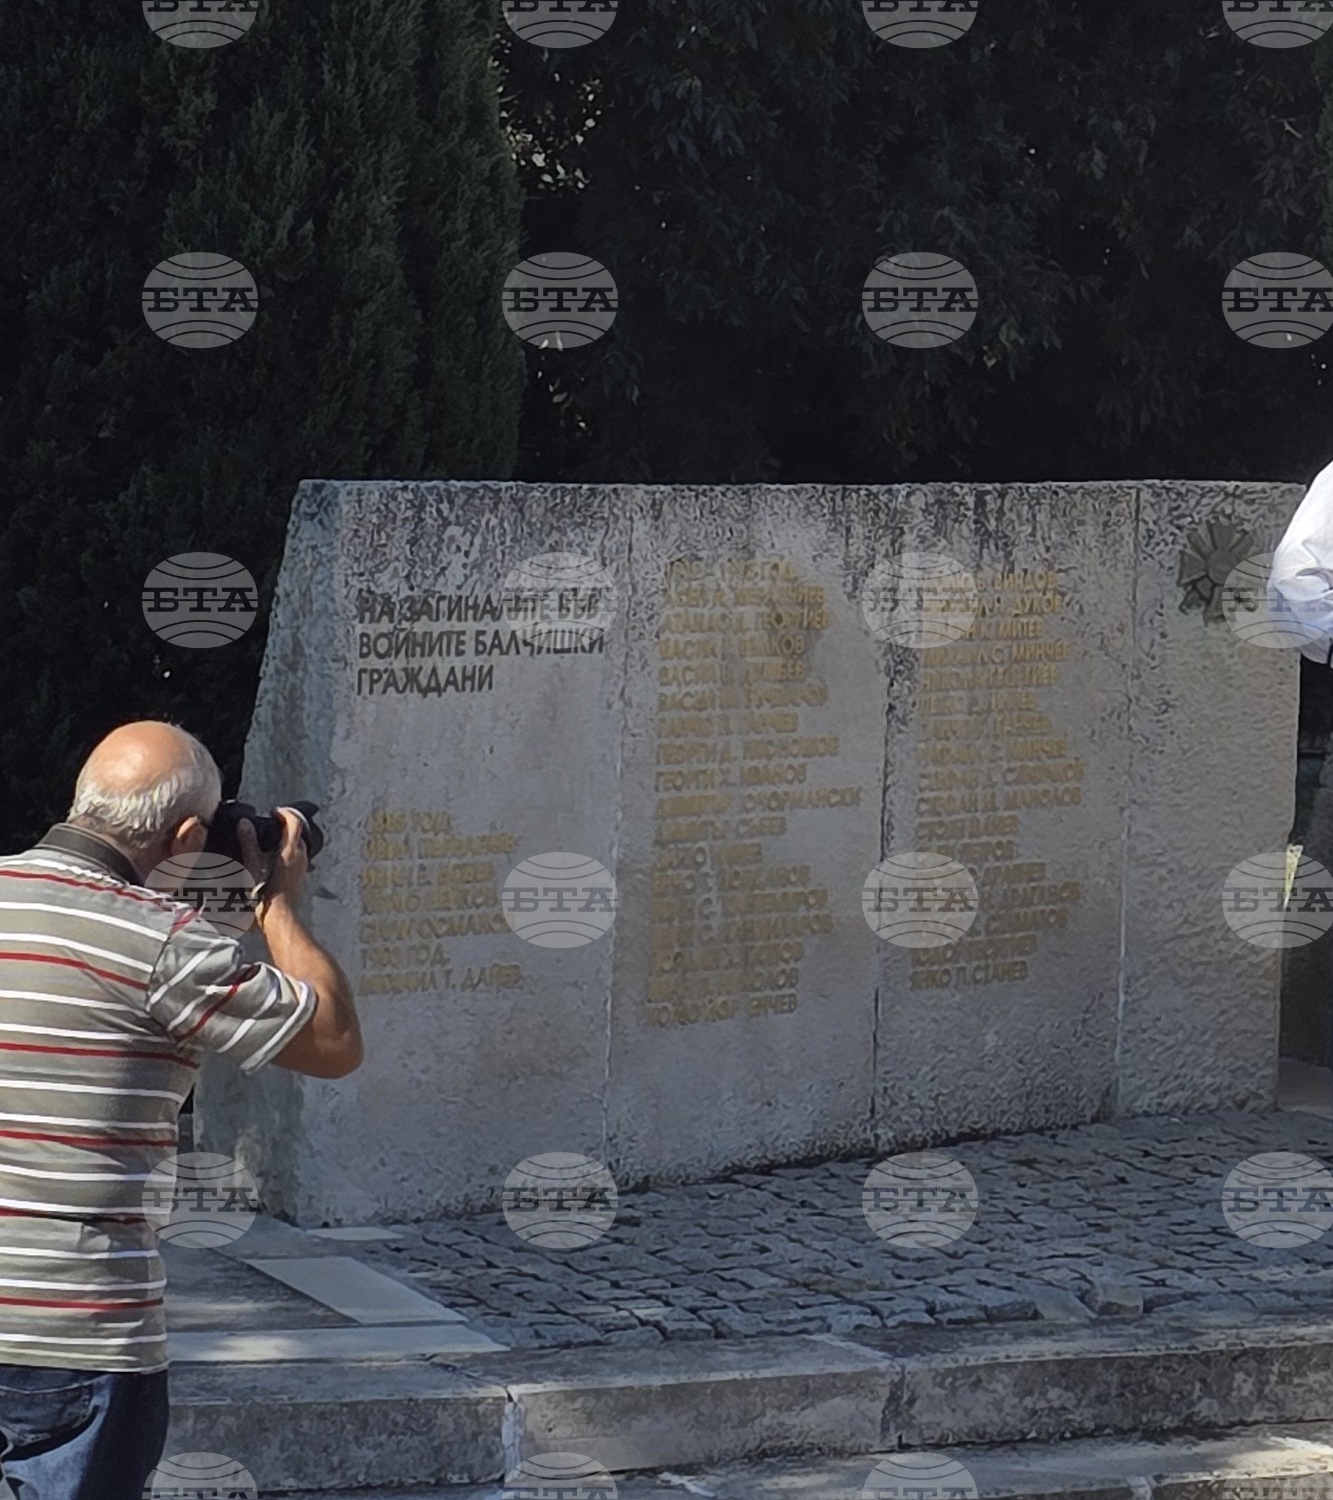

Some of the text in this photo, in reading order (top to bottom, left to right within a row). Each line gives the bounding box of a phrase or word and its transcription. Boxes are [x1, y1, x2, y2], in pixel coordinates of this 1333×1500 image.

[358, 591, 396, 625] НА
[401, 591, 553, 624] ЗАГИНАЛИТЕ
[358, 627, 605, 660] ВОЙНИТЕ БАЛЧИШКИ
[356, 664, 495, 698] ГРАЖДАНИ
